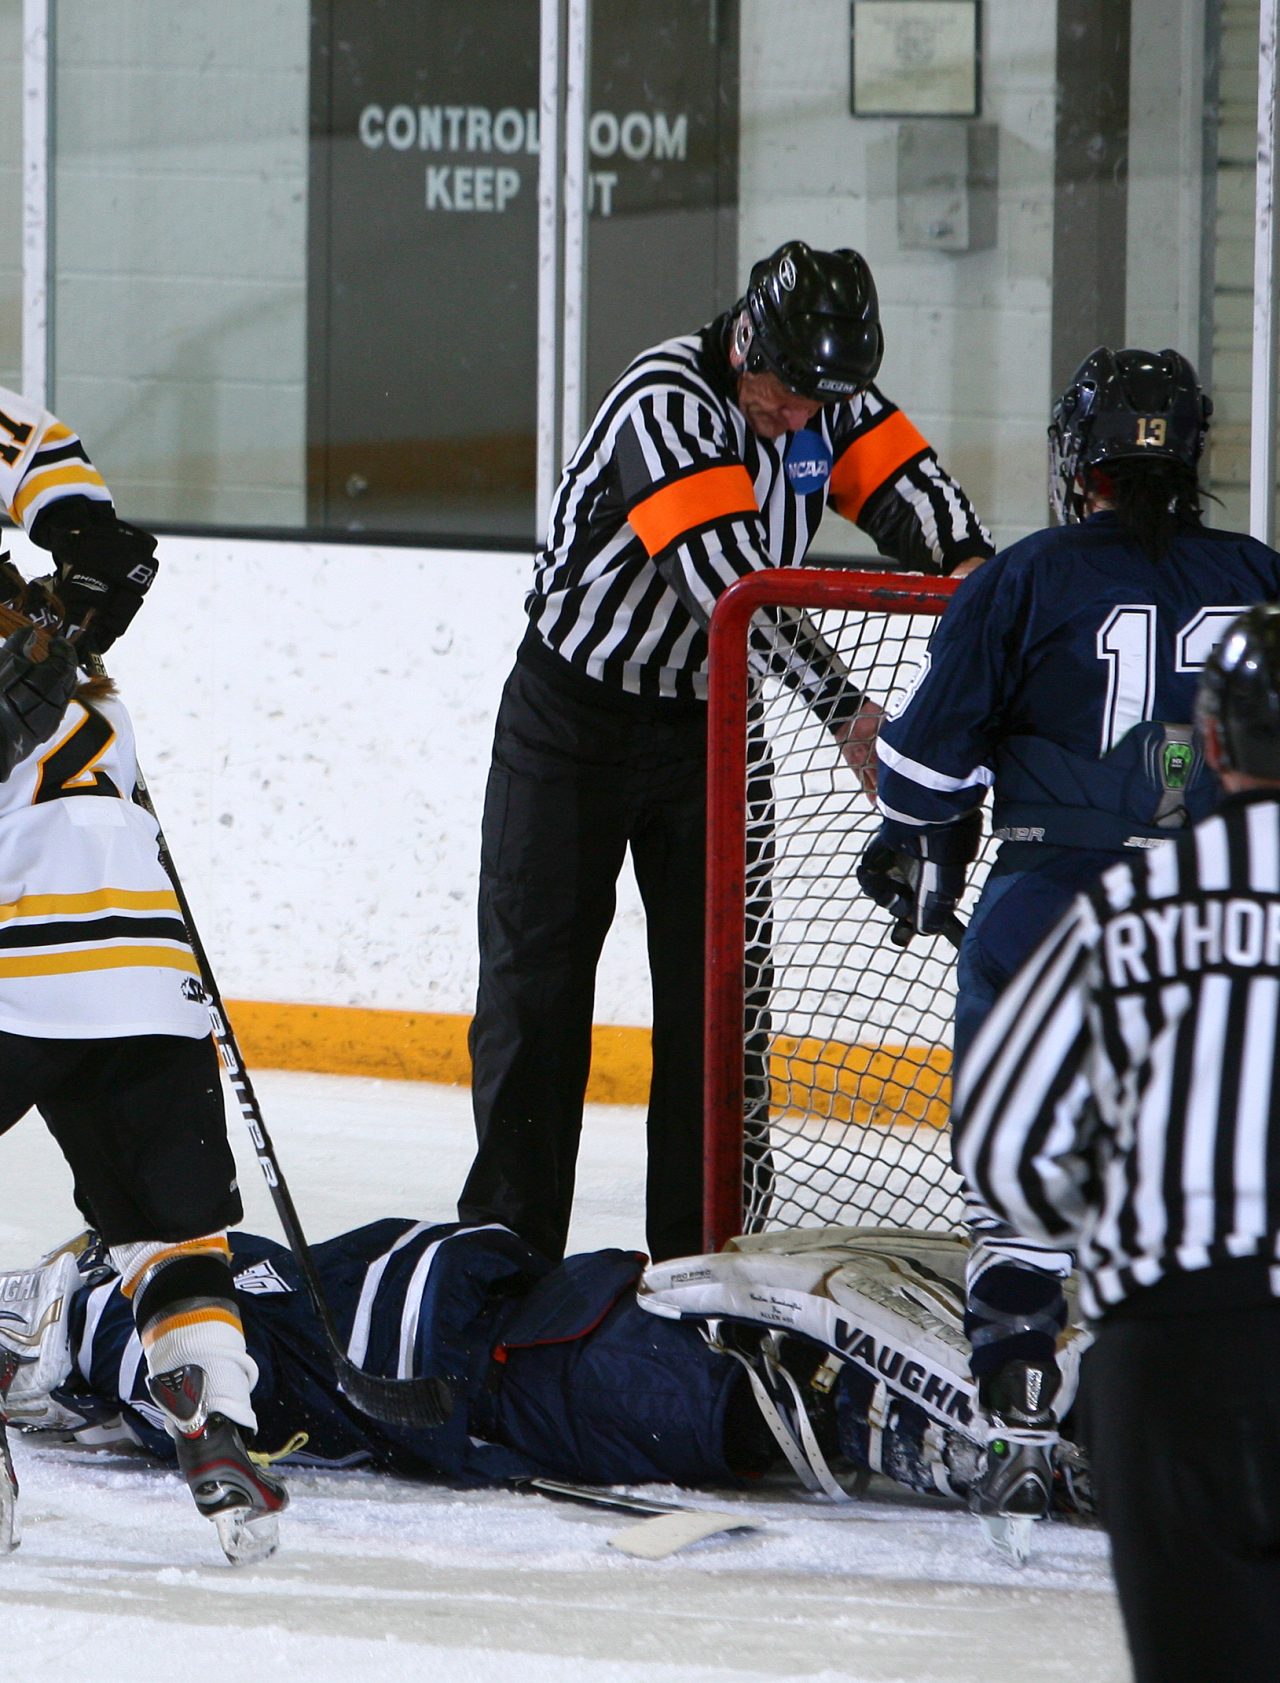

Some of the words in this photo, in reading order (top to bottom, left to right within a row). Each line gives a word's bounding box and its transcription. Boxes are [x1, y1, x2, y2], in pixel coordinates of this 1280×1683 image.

[589, 111, 687, 160] OOM
[426, 165, 520, 212] KEEP
[1136, 417, 1167, 446] 13
[788, 460, 829, 479] NCAA
